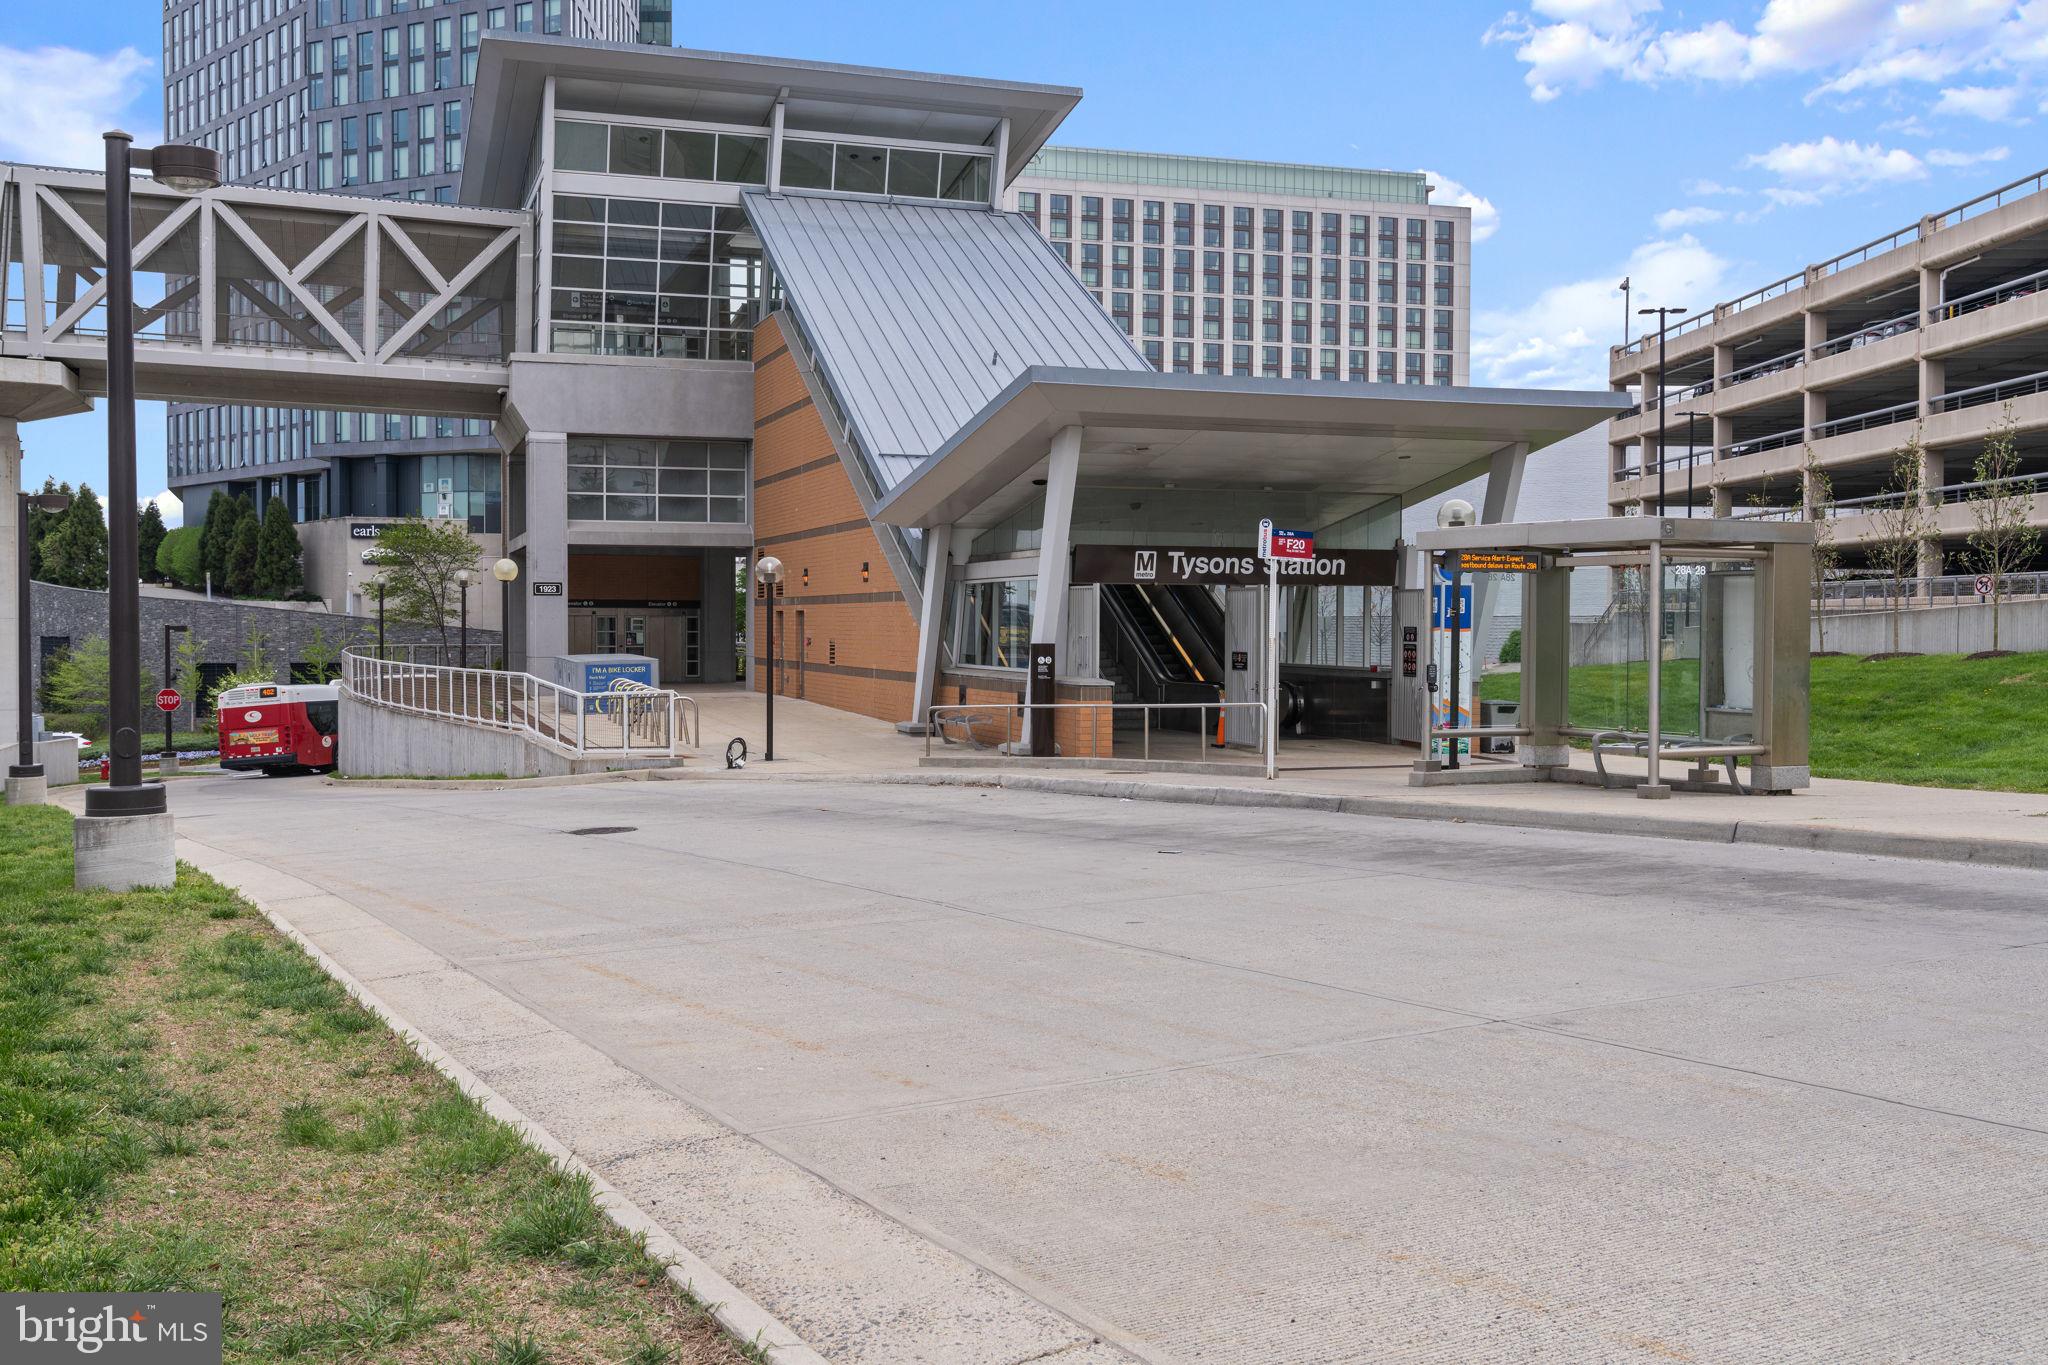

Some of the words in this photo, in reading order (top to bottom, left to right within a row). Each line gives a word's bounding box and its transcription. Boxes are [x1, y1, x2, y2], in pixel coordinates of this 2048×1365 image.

[353, 525, 381, 537] earls
[1286, 539, 1306, 550] F20
[1168, 552, 1254, 579] Tysons
[1263, 553, 1345, 576] Station
[1675, 565, 1692, 575] 28A
[1695, 566, 1706, 575] 28
[539, 585, 557, 593] 1923
[262, 688, 276, 696] 402
[158, 695, 180, 705] STOP
